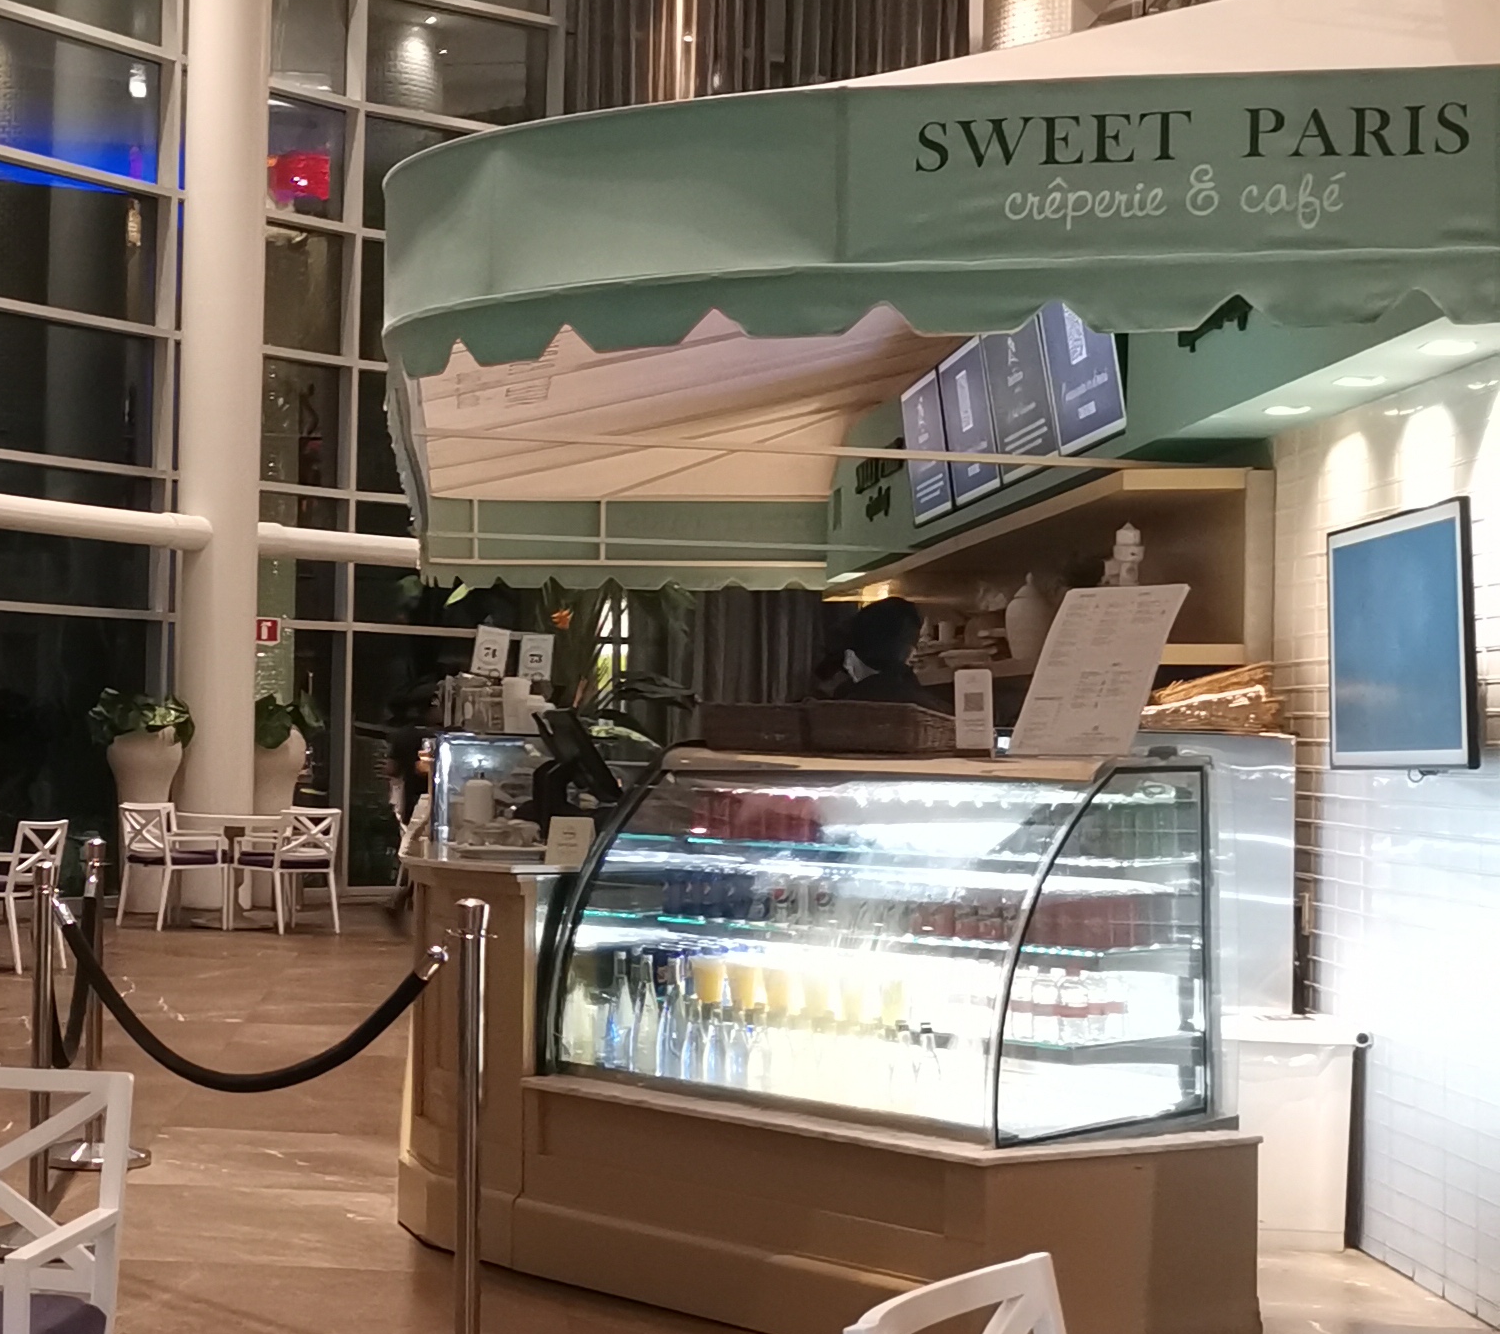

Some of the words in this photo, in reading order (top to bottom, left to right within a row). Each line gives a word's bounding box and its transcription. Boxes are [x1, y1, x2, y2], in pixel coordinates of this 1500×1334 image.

[915, 110, 1192, 173] SWEET
[1241, 102, 1470, 158] PARIS
[1004, 176, 1167, 231] crêperie
[1185, 164, 1219, 216] &
[1240, 171, 1346, 229] café
